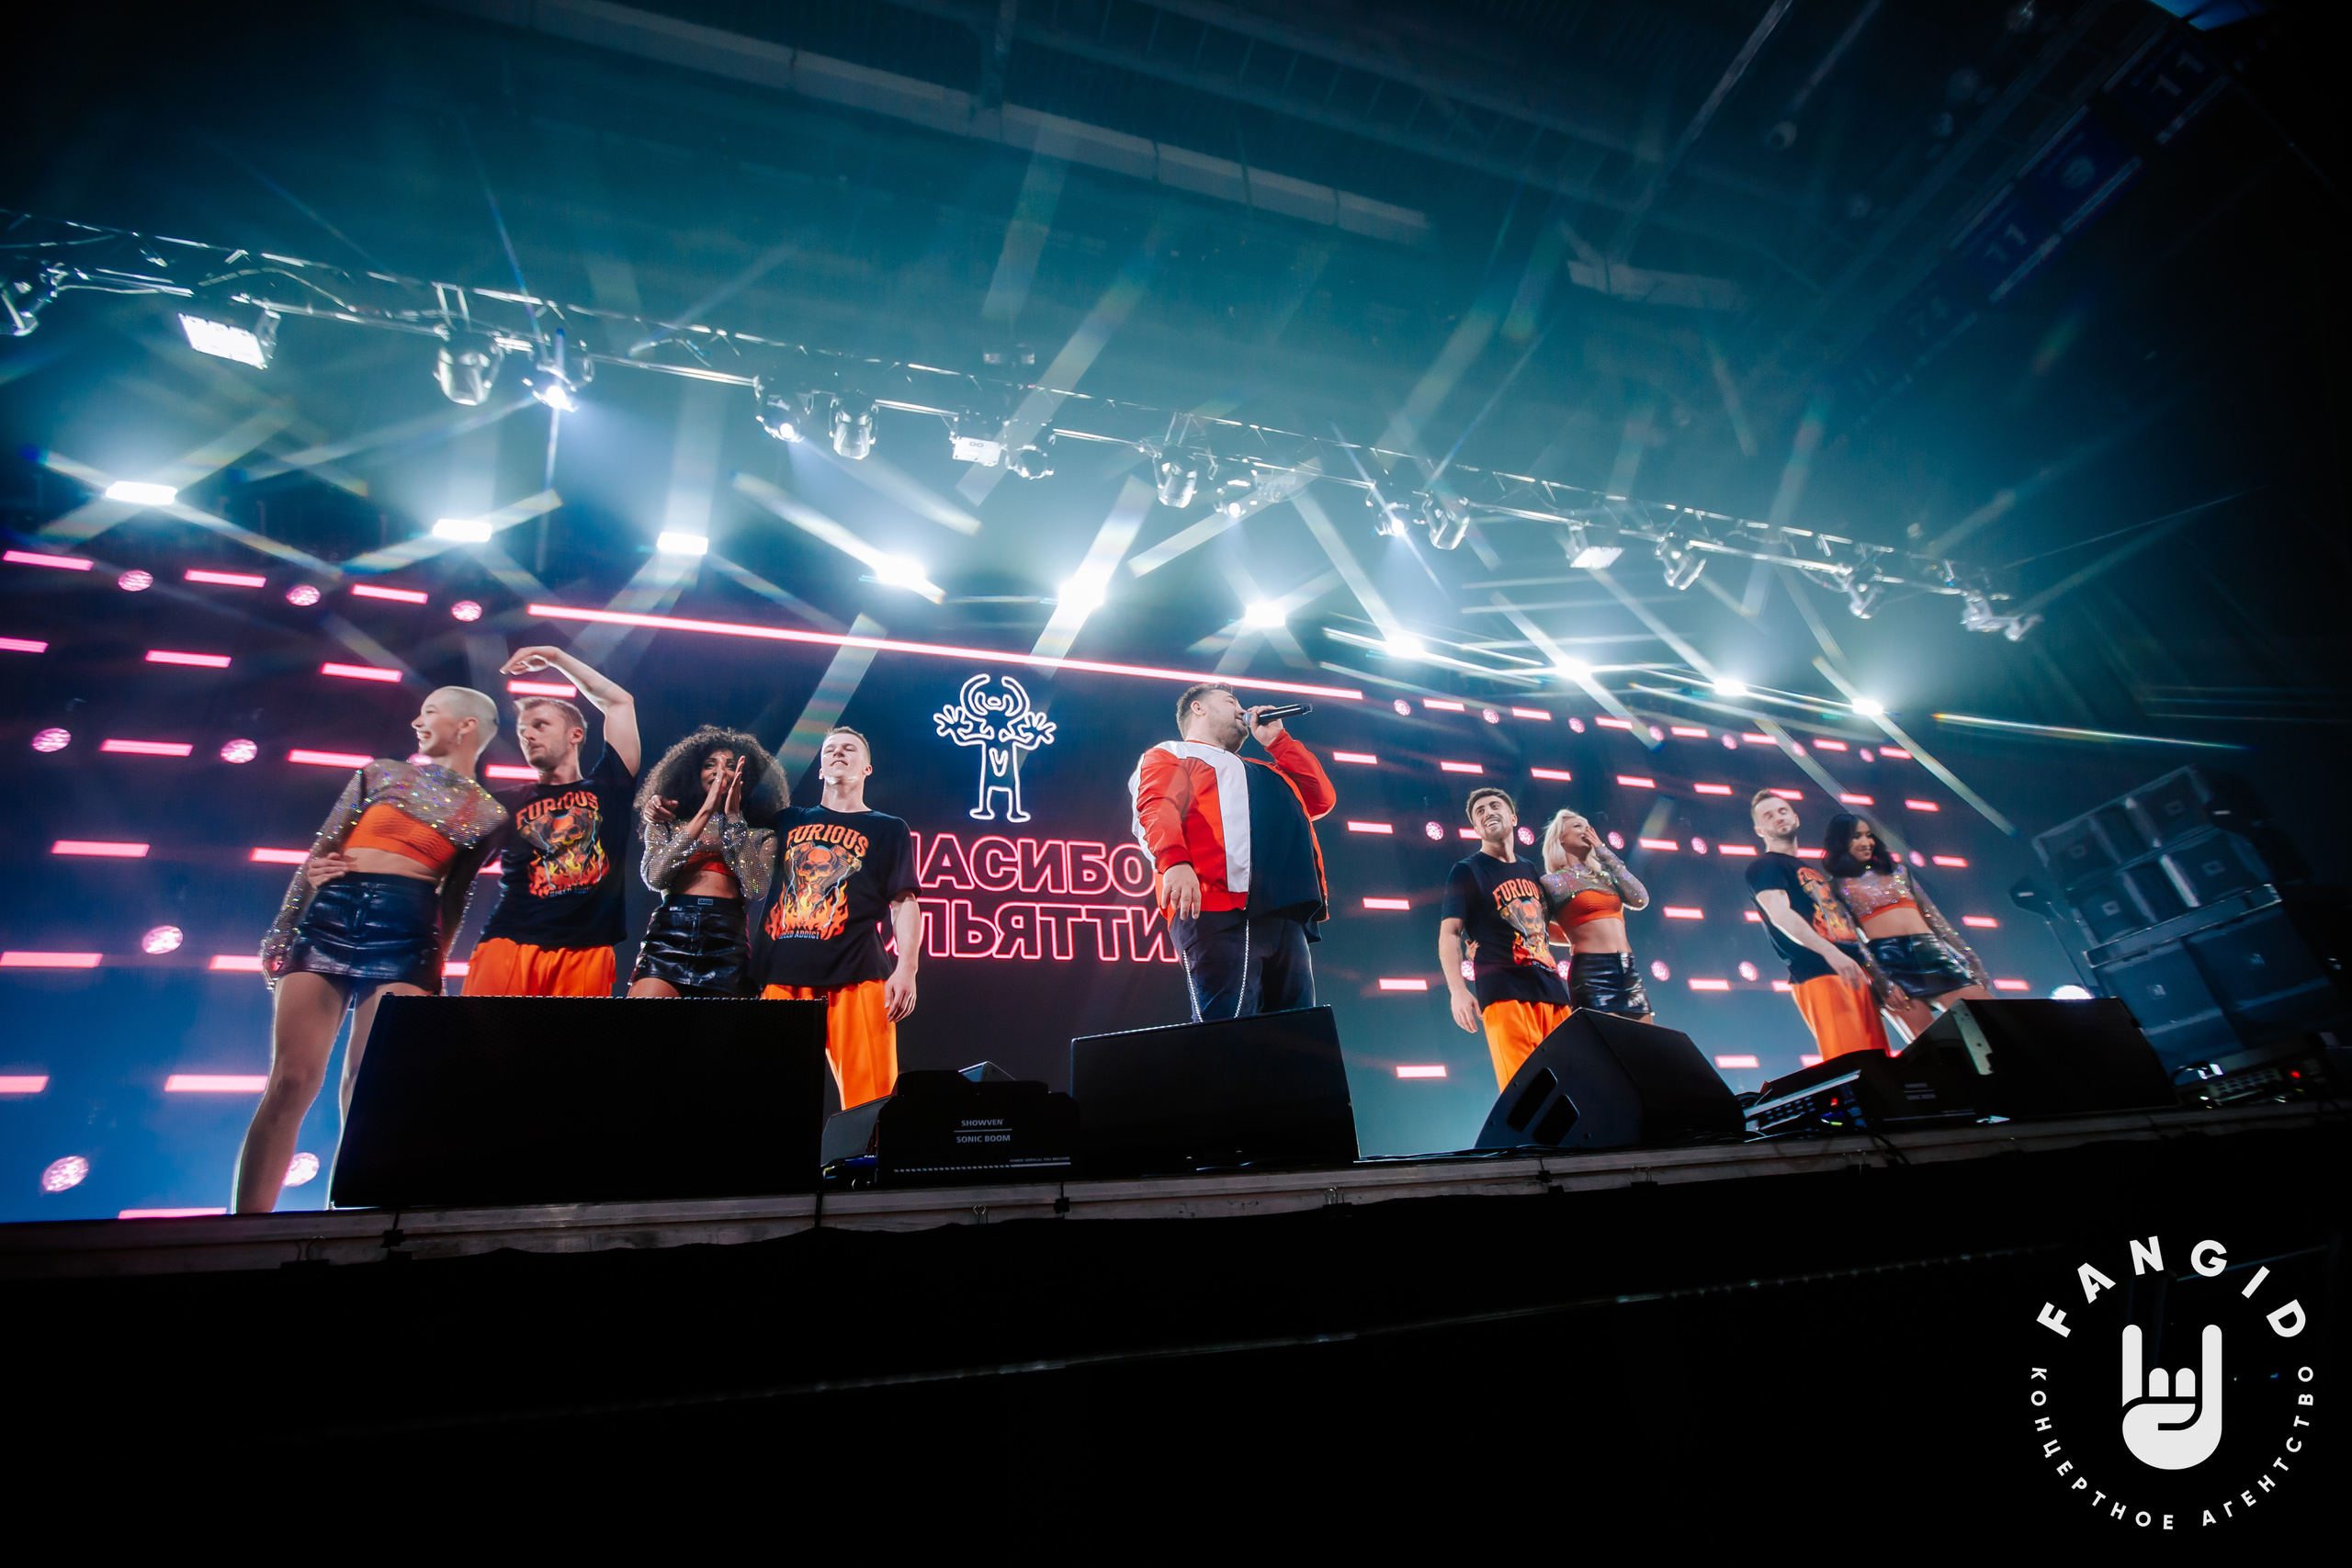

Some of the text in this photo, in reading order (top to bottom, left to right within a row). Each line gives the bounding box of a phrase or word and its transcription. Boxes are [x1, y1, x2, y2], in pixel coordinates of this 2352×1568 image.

[515, 791, 599, 830] FURIOUS
[786, 823, 869, 857] FURIOUS
[1492, 878, 1540, 910] FURIOU
[794, 930, 820, 940] ADDICT
[876, 897, 1180, 963] ЛЬЯТТИ
[956, 1134, 1011, 1144] SONIC BOOM
